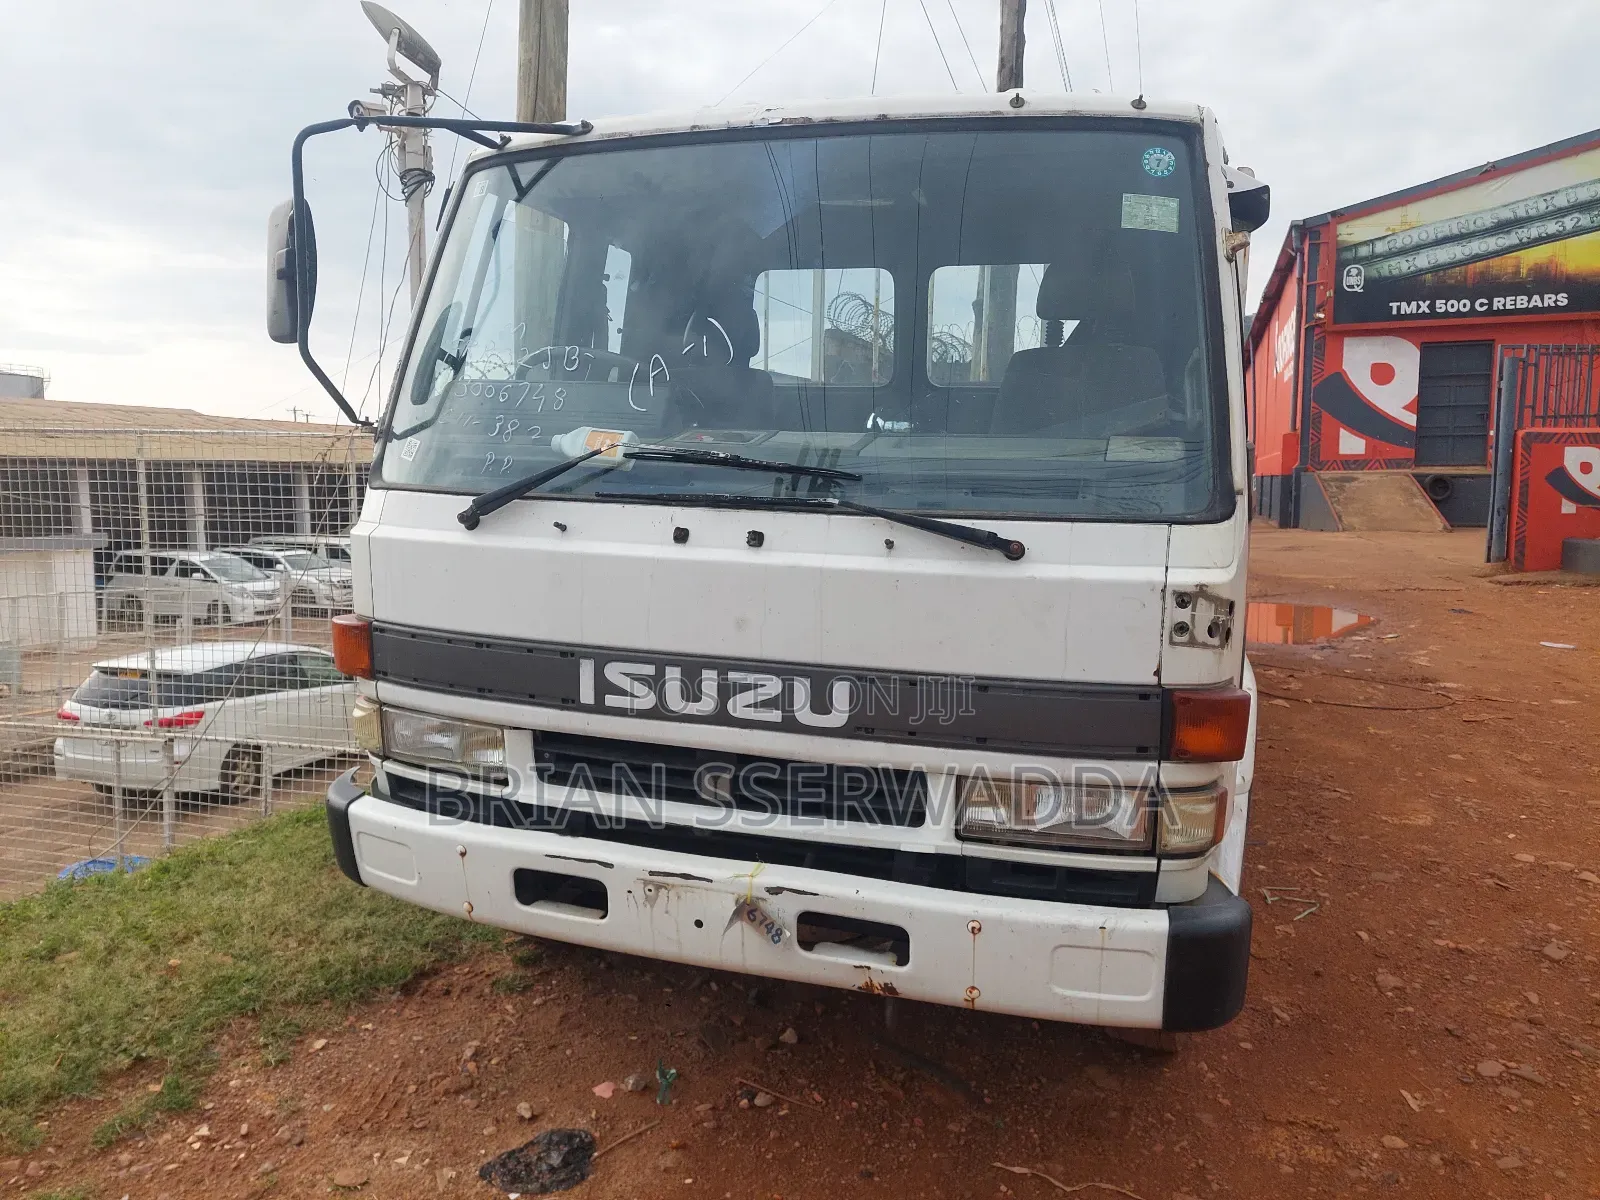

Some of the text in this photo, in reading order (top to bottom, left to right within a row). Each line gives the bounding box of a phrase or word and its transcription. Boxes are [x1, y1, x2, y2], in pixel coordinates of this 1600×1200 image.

[1389, 293, 1569, 315] TMX 500 C REBARS
[578, 656, 852, 729] ISUZU
[747, 907, 783, 944] 6748
